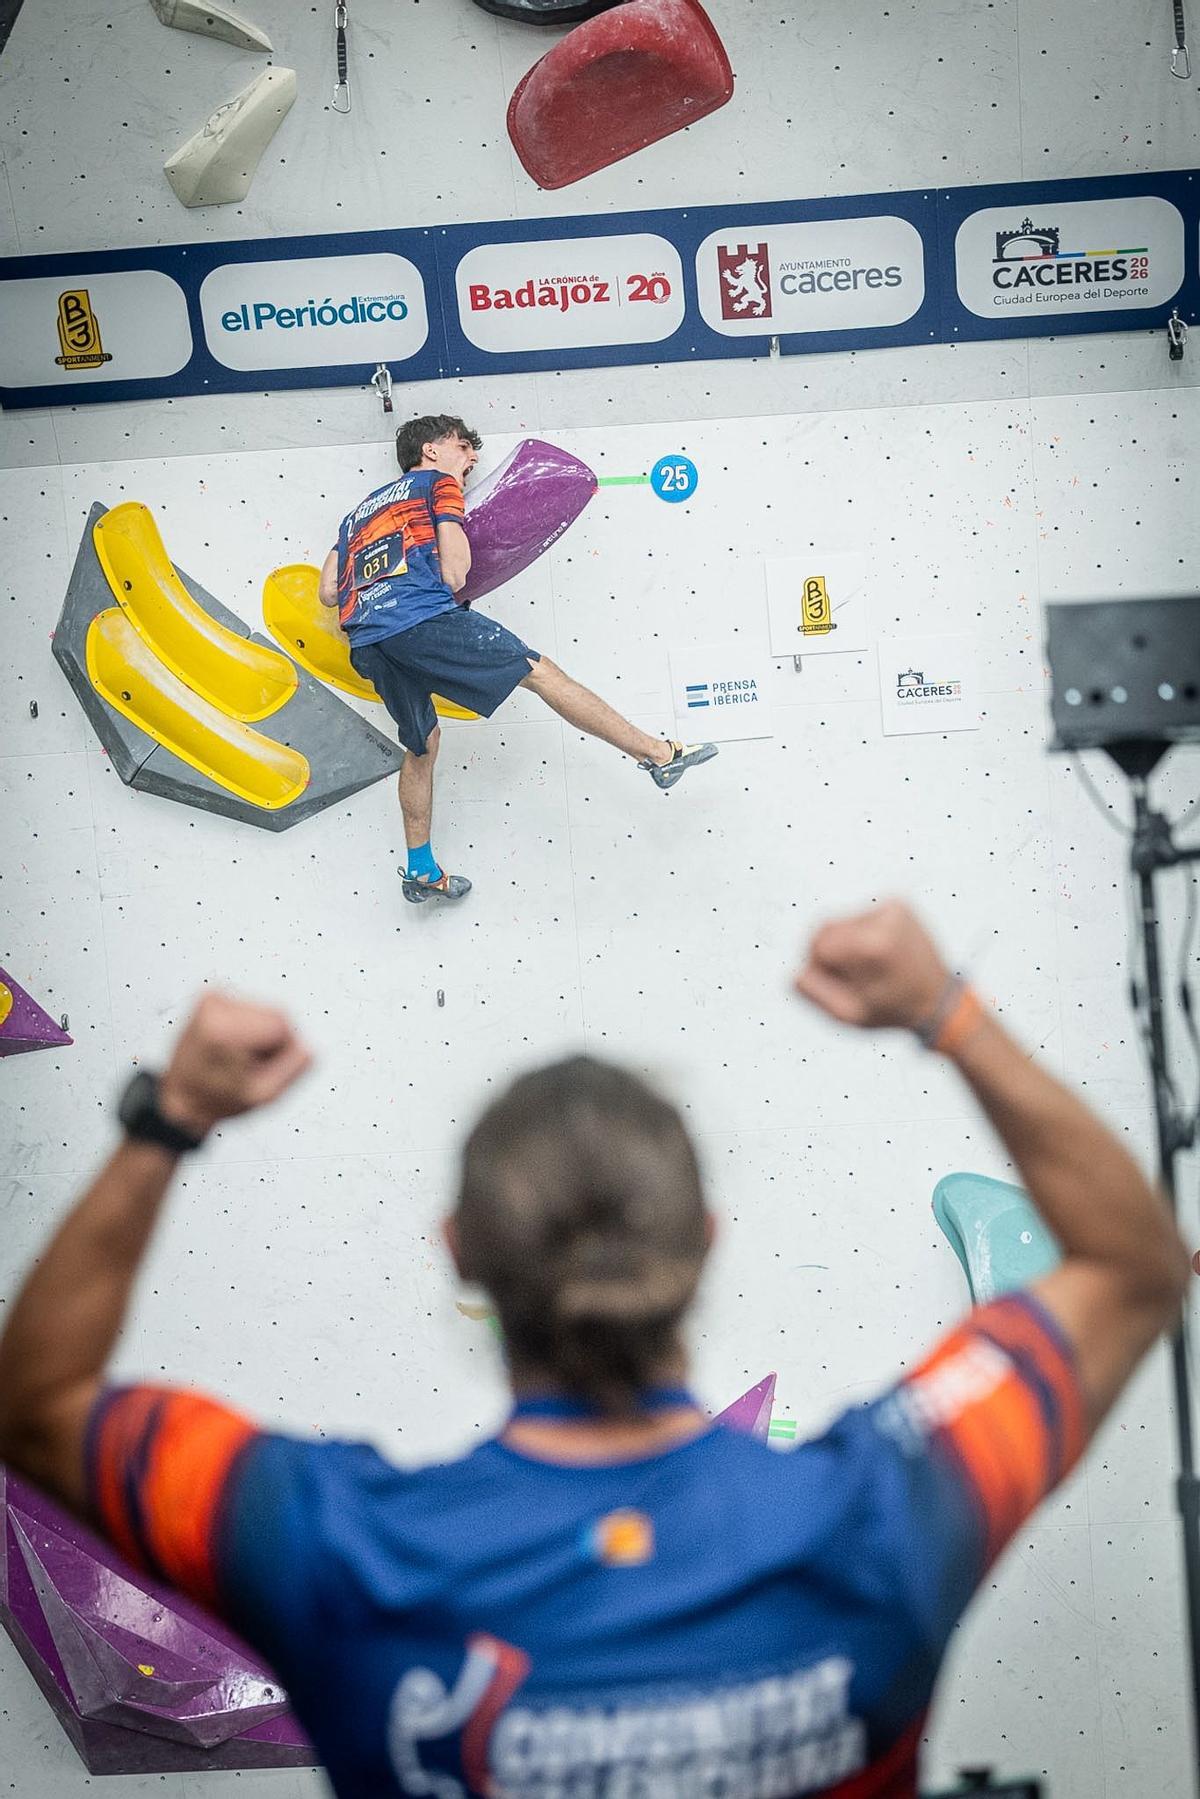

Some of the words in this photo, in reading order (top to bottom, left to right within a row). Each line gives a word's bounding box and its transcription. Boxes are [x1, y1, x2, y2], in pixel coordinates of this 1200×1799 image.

[779, 258, 851, 271] AYUNTAMIENTO
[1130, 257, 1148, 268] 20
[551, 274, 588, 284] CRÓNICA
[589, 274, 600, 282] de
[1130, 268, 1148, 279] 26
[469, 280, 610, 312] Badajoz
[626, 274, 671, 303] 20
[358, 294, 406, 303] Extremadura
[993, 294, 1033, 305] Ciudad
[1035, 292, 1081, 304] Europea
[1083, 288, 1101, 299] del
[1103, 288, 1149, 299] Deporte
[221, 304, 250, 332] el
[253, 296, 408, 330] Periódico
[660, 465, 689, 491] 25
[363, 553, 388, 579] 031
[712, 679, 757, 693] PRENSA
